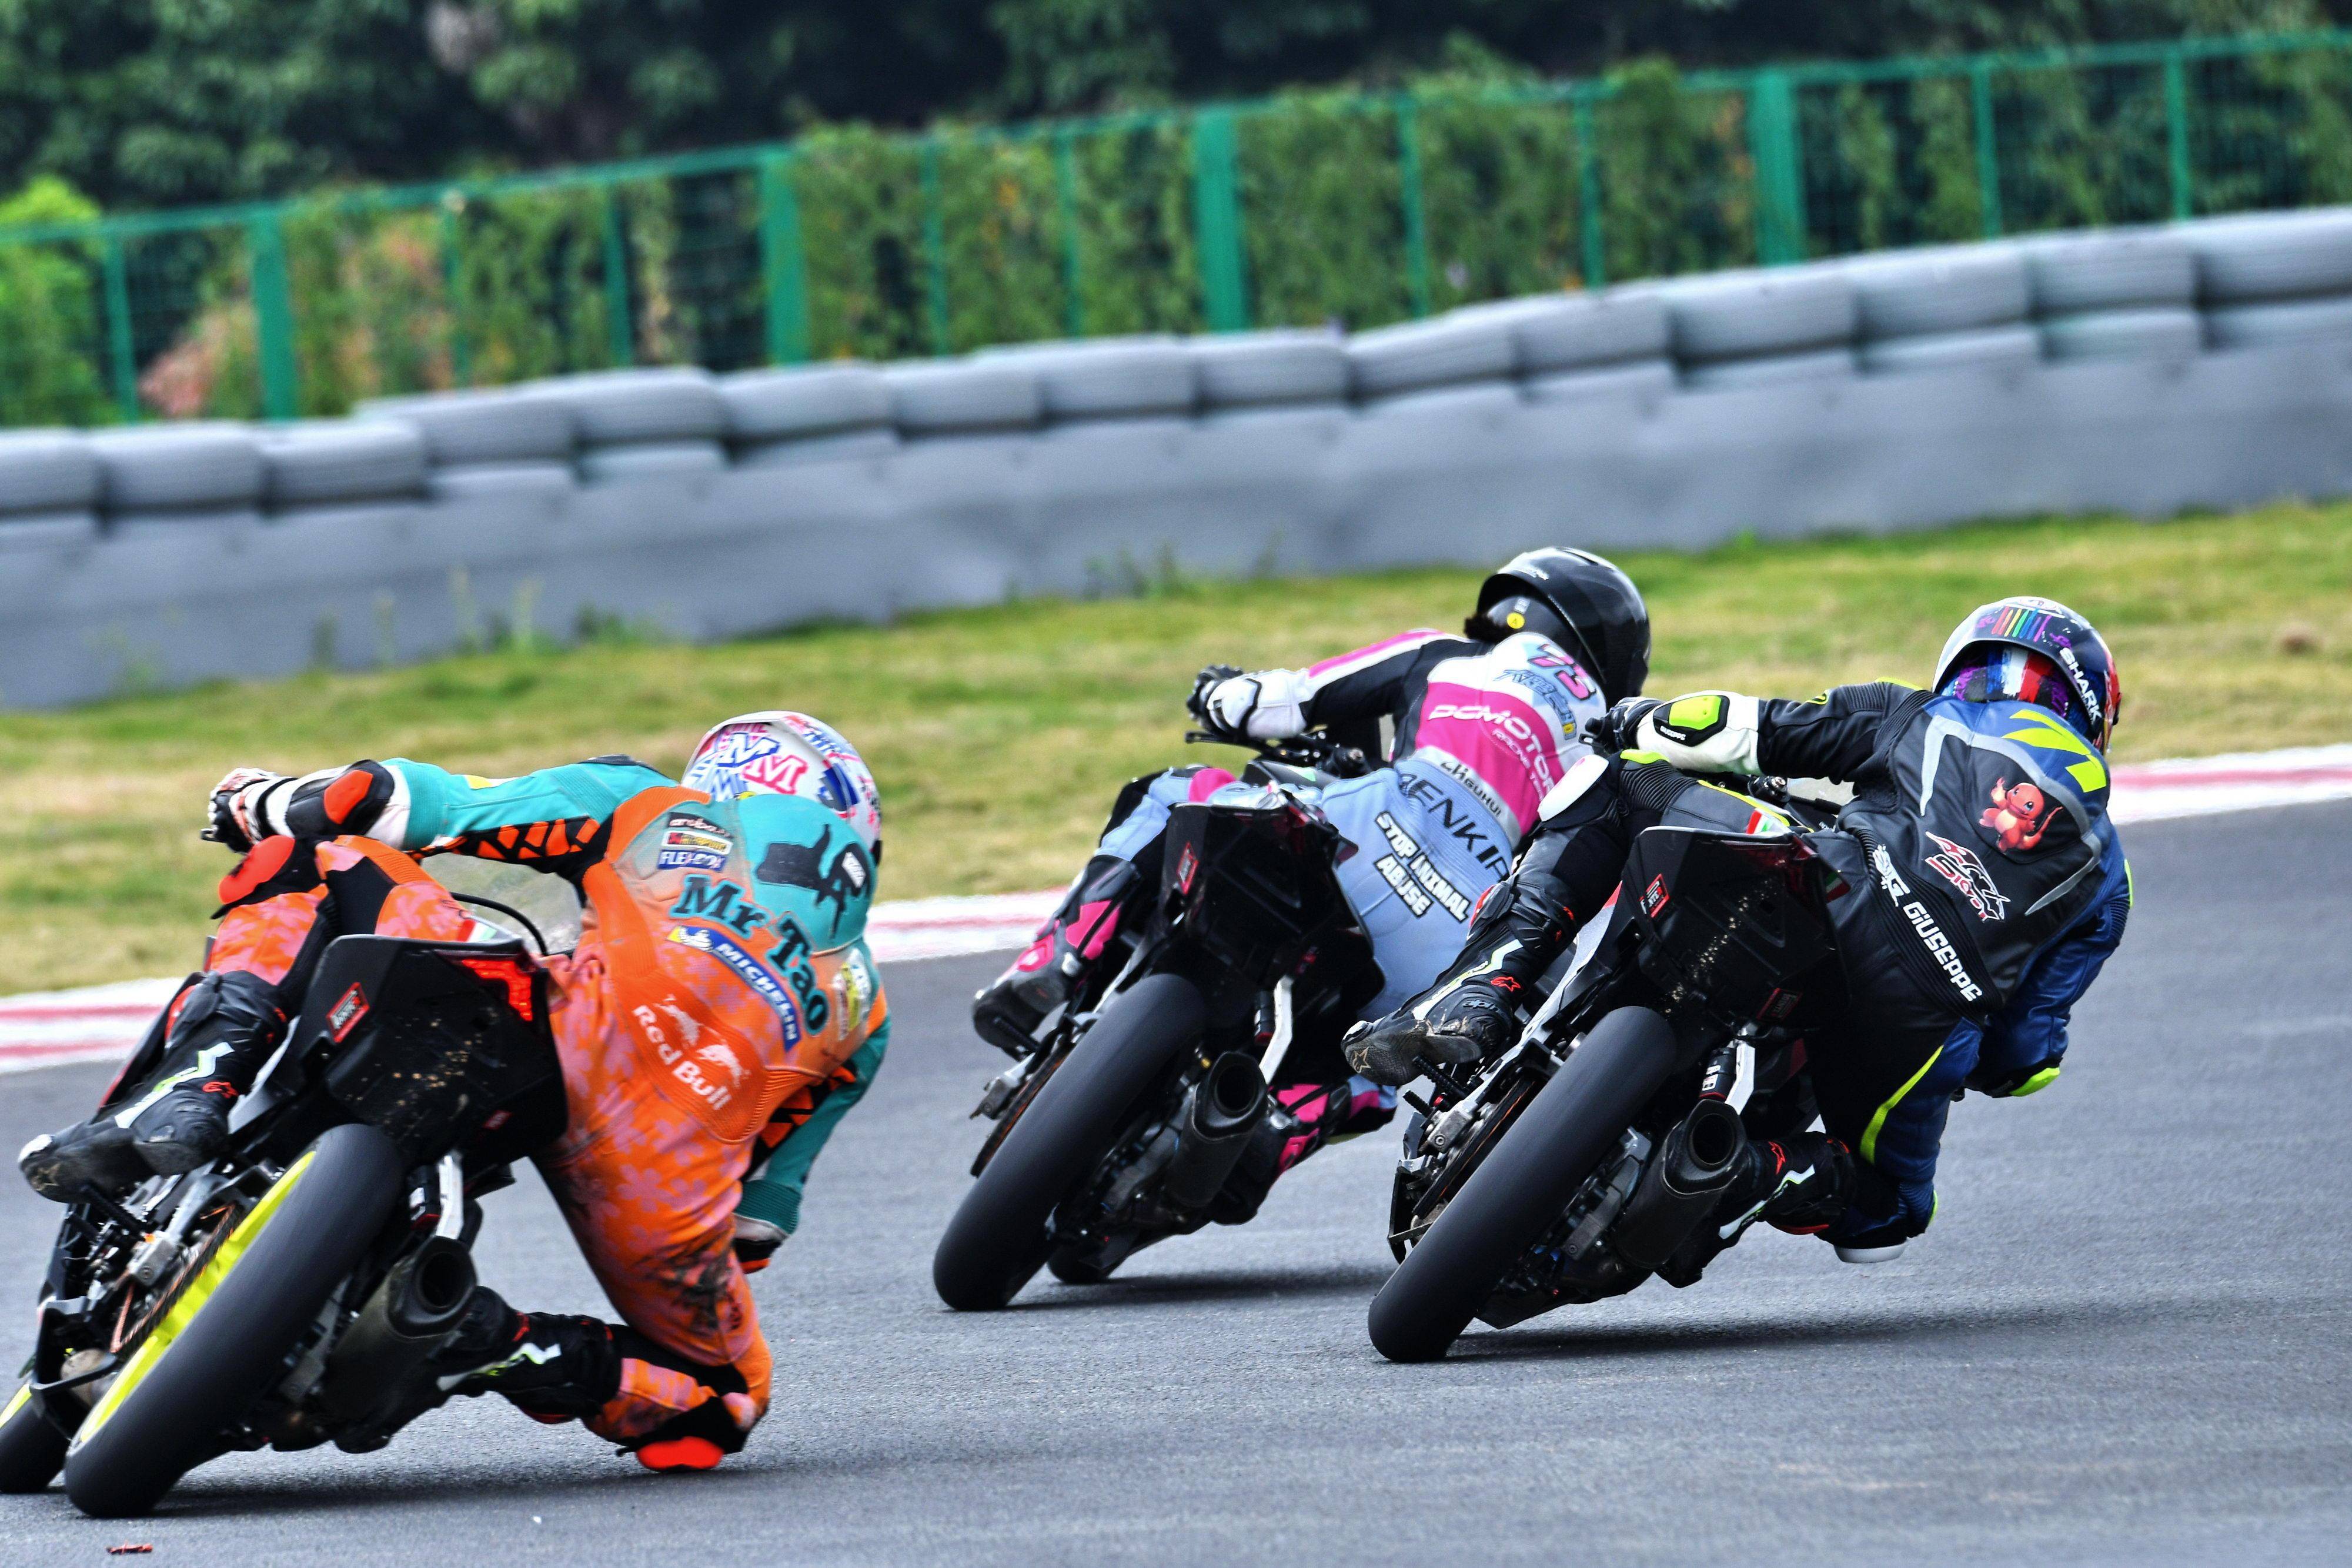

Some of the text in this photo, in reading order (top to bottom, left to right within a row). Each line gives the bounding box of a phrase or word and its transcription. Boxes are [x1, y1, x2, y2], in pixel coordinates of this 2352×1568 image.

[2059, 647, 2103, 724] SHARK
[1375, 812, 1421, 858] STOP
[1374, 855, 1432, 916] ABUSE
[673, 876, 766, 934] Mr
[771, 917, 829, 1032] Tao
[716, 942, 797, 1040] MICHELIN
[632, 1005, 732, 1111] Red Bull
